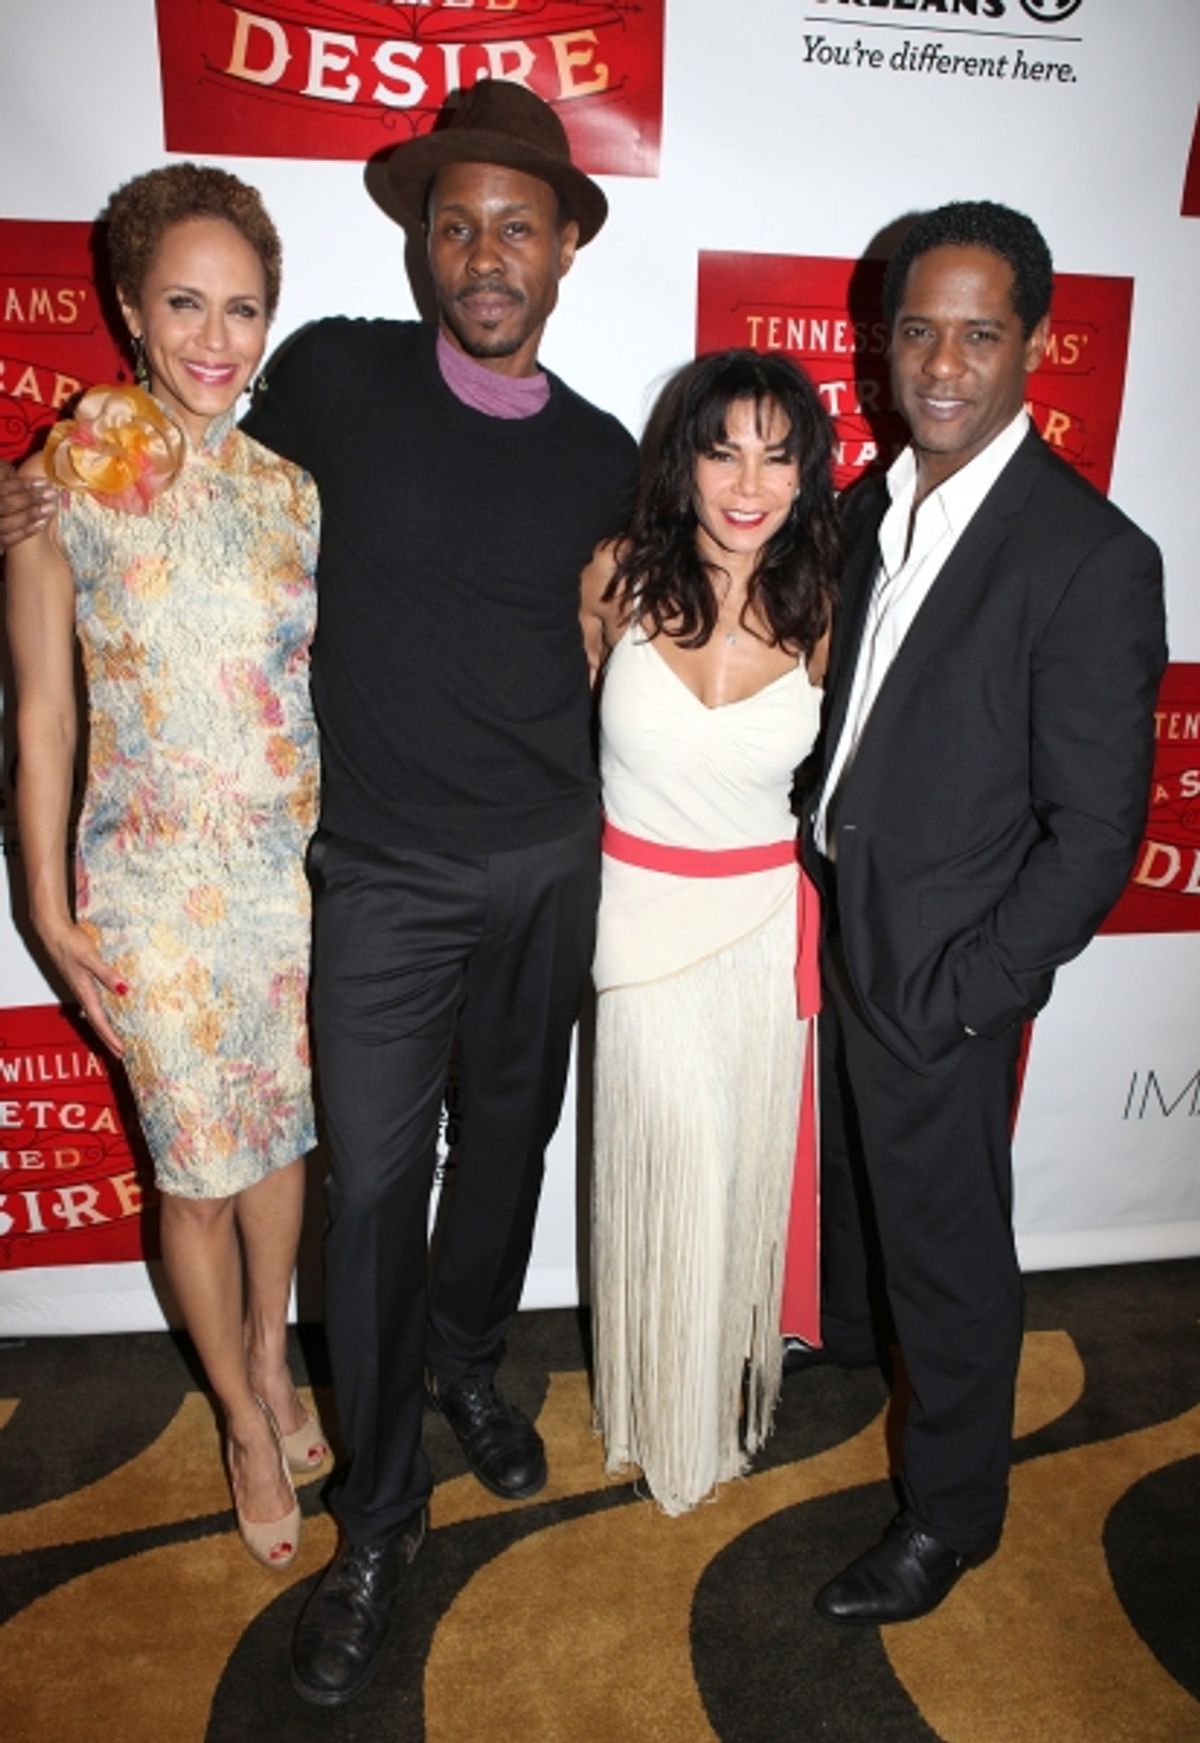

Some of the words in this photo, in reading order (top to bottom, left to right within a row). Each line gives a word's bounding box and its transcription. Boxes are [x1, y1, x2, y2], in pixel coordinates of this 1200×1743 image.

[226, 9, 609, 108] DESIRE
[802, 35, 884, 68] You're
[889, 40, 1008, 78] different
[1011, 49, 1078, 82] here.
